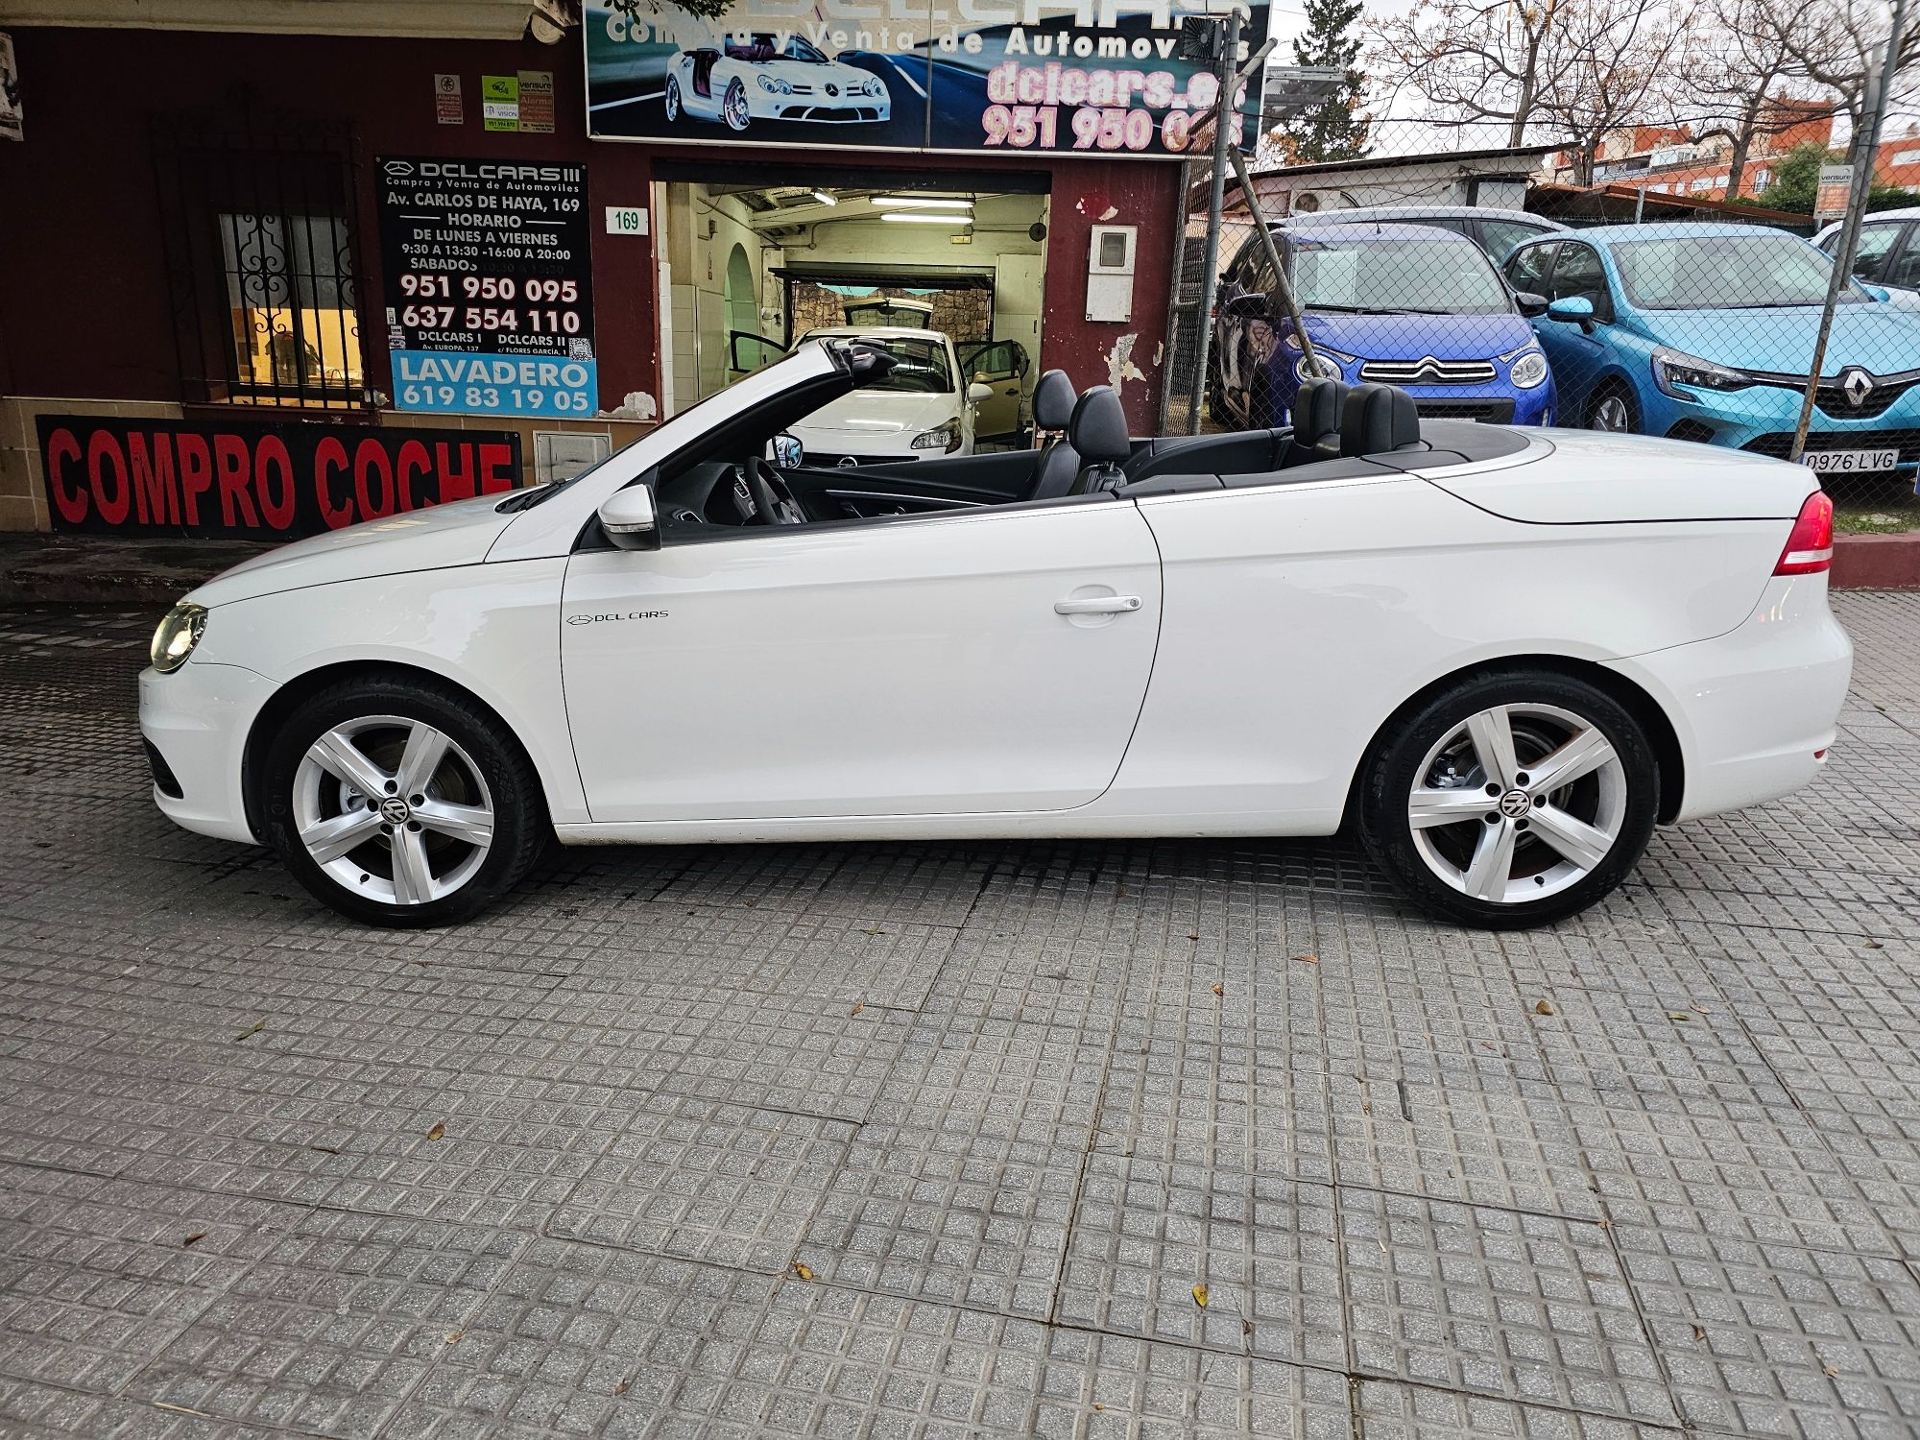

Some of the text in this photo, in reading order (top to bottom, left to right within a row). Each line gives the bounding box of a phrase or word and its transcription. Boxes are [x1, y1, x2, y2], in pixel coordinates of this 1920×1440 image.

[774, 28, 793, 55] y
[807, 23, 915, 51] Venta
[938, 25, 983, 54] de
[982, 105, 1058, 148] 951
[1071, 107, 1153, 150] 950
[386, 176, 580, 193] Compra y Venta de Automoviles
[387, 191, 580, 213] Av. CARLOS DE HAYA, 169
[447, 213, 522, 228] HORARIO
[615, 211, 639, 230] 169
[413, 228, 559, 246] DE LUNES A VIERNES
[401, 243, 429, 254] 9:30
[432, 245, 442, 255] A
[445, 245, 479, 257] 13:30
[524, 249, 534, 259] A
[537, 249, 571, 260] 20:00
[400, 274, 578, 303] 951 950 095
[402, 305, 456, 328] 637
[465, 307, 518, 331] 554
[527, 310, 581, 334] 110
[418, 331, 474, 343] DCLCARS
[477, 333, 482, 343] I
[498, 333, 566, 347] DCLCARS II
[506, 347, 532, 355] FLORES
[401, 357, 589, 388] LAVADERO
[403, 384, 589, 411] 619 83 19 05
[1806, 452, 1894, 470] 0976 LVG
[48, 427, 296, 531] COMPRO
[594, 609, 669, 622] DCL CARS
